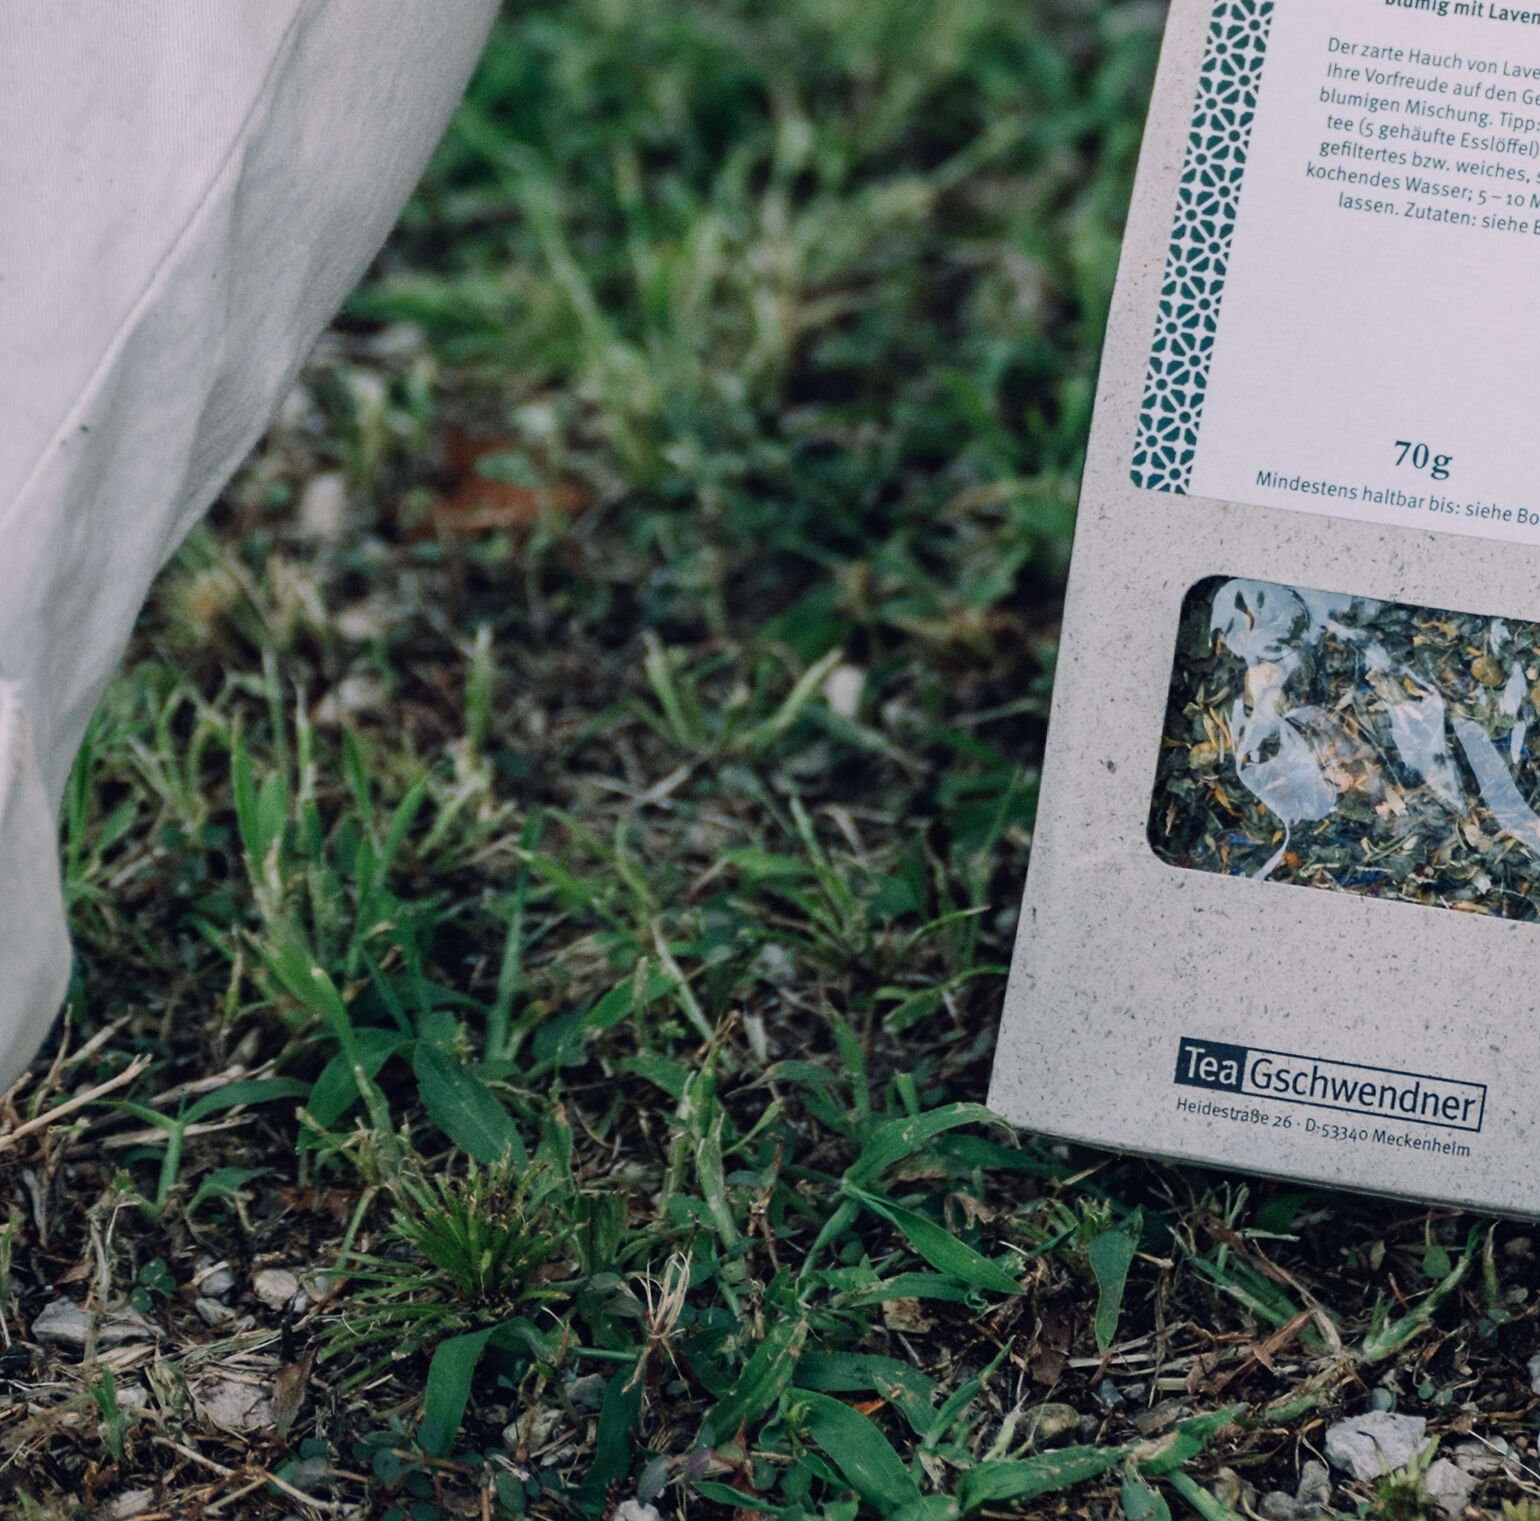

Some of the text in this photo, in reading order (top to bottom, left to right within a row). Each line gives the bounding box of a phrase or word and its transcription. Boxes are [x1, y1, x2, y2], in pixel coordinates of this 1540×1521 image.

[1453, 0, 1484, 18] mit
[1328, 37, 1358, 55] Der
[1360, 45, 1404, 62] zarte
[1408, 48, 1462, 69] Hauch
[1467, 59, 1498, 74] von
[1327, 62, 1360, 81] Ihre
[1365, 67, 1448, 94] Vorfreude
[1452, 82, 1482, 98] auf
[1485, 84, 1517, 103] den
[1319, 86, 1400, 113] blumigen
[1405, 99, 1493, 128] Mischung.
[1500, 111, 1540, 134] Tipp:
[1327, 114, 1354, 132] tee
[1359, 117, 1374, 138] (5
[1378, 123, 1456, 146] gehäufte
[1460, 132, 1540, 159] Esslöffel)
[1306, 161, 1400, 190] kochendes
[1405, 176, 1473, 202] Wasser;
[1477, 190, 1487, 206] 5
[1506, 194, 1525, 207] 10
[1319, 140, 1407, 165] gefiltertes
[1412, 151, 1450, 171] bzw.
[1456, 160, 1530, 184] weiches,
[1338, 191, 1399, 216] lassen.
[1404, 201, 1477, 227] Zutaten:
[1481, 213, 1529, 234] siehe
[1256, 470, 1358, 500] Mindestens
[1362, 485, 1426, 509] haltbar
[1428, 495, 1460, 515] bis:
[1465, 501, 1512, 522] siehe
[1184, 1046, 1477, 1122] Tea Gschwendner
[1176, 1097, 1269, 1125] Heidestraße
[1272, 1115, 1292, 1129] 26
[1372, 1128, 1471, 1157] Meckenheim
